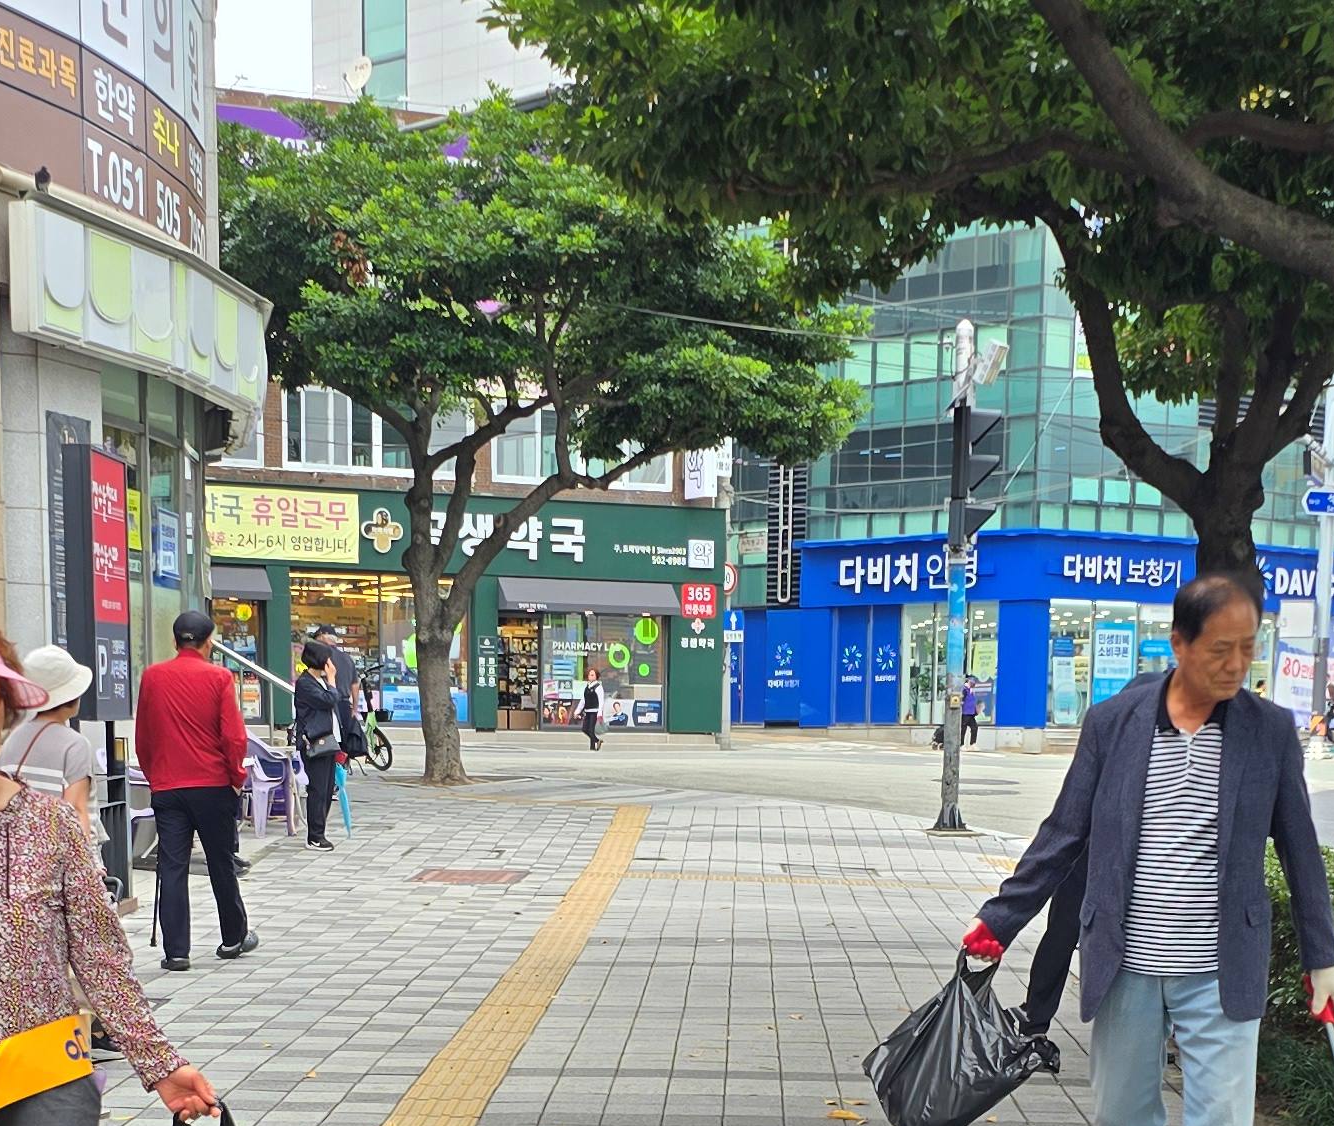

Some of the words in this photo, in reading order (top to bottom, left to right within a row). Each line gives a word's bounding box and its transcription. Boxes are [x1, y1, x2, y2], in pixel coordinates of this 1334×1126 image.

[93, 67, 137, 136] 한약
[153, 107, 180, 168] 추나
[87, 137, 146, 218] T.051
[156, 179, 182, 241] 505
[251, 495, 349, 531] 휴일근무
[237, 533, 286, 551] 2시~6시
[290, 535, 352, 553] 영업합니다.
[693, 543, 713, 567] 약
[839, 552, 919, 594] 다비치
[1063, 553, 1122, 586] 다비치
[1125, 557, 1182, 589] 보청기
[687, 586, 712, 602] 365
[552, 641, 603, 652] PHARMACY
[1097, 646, 1129, 658] 소비쿠폰
